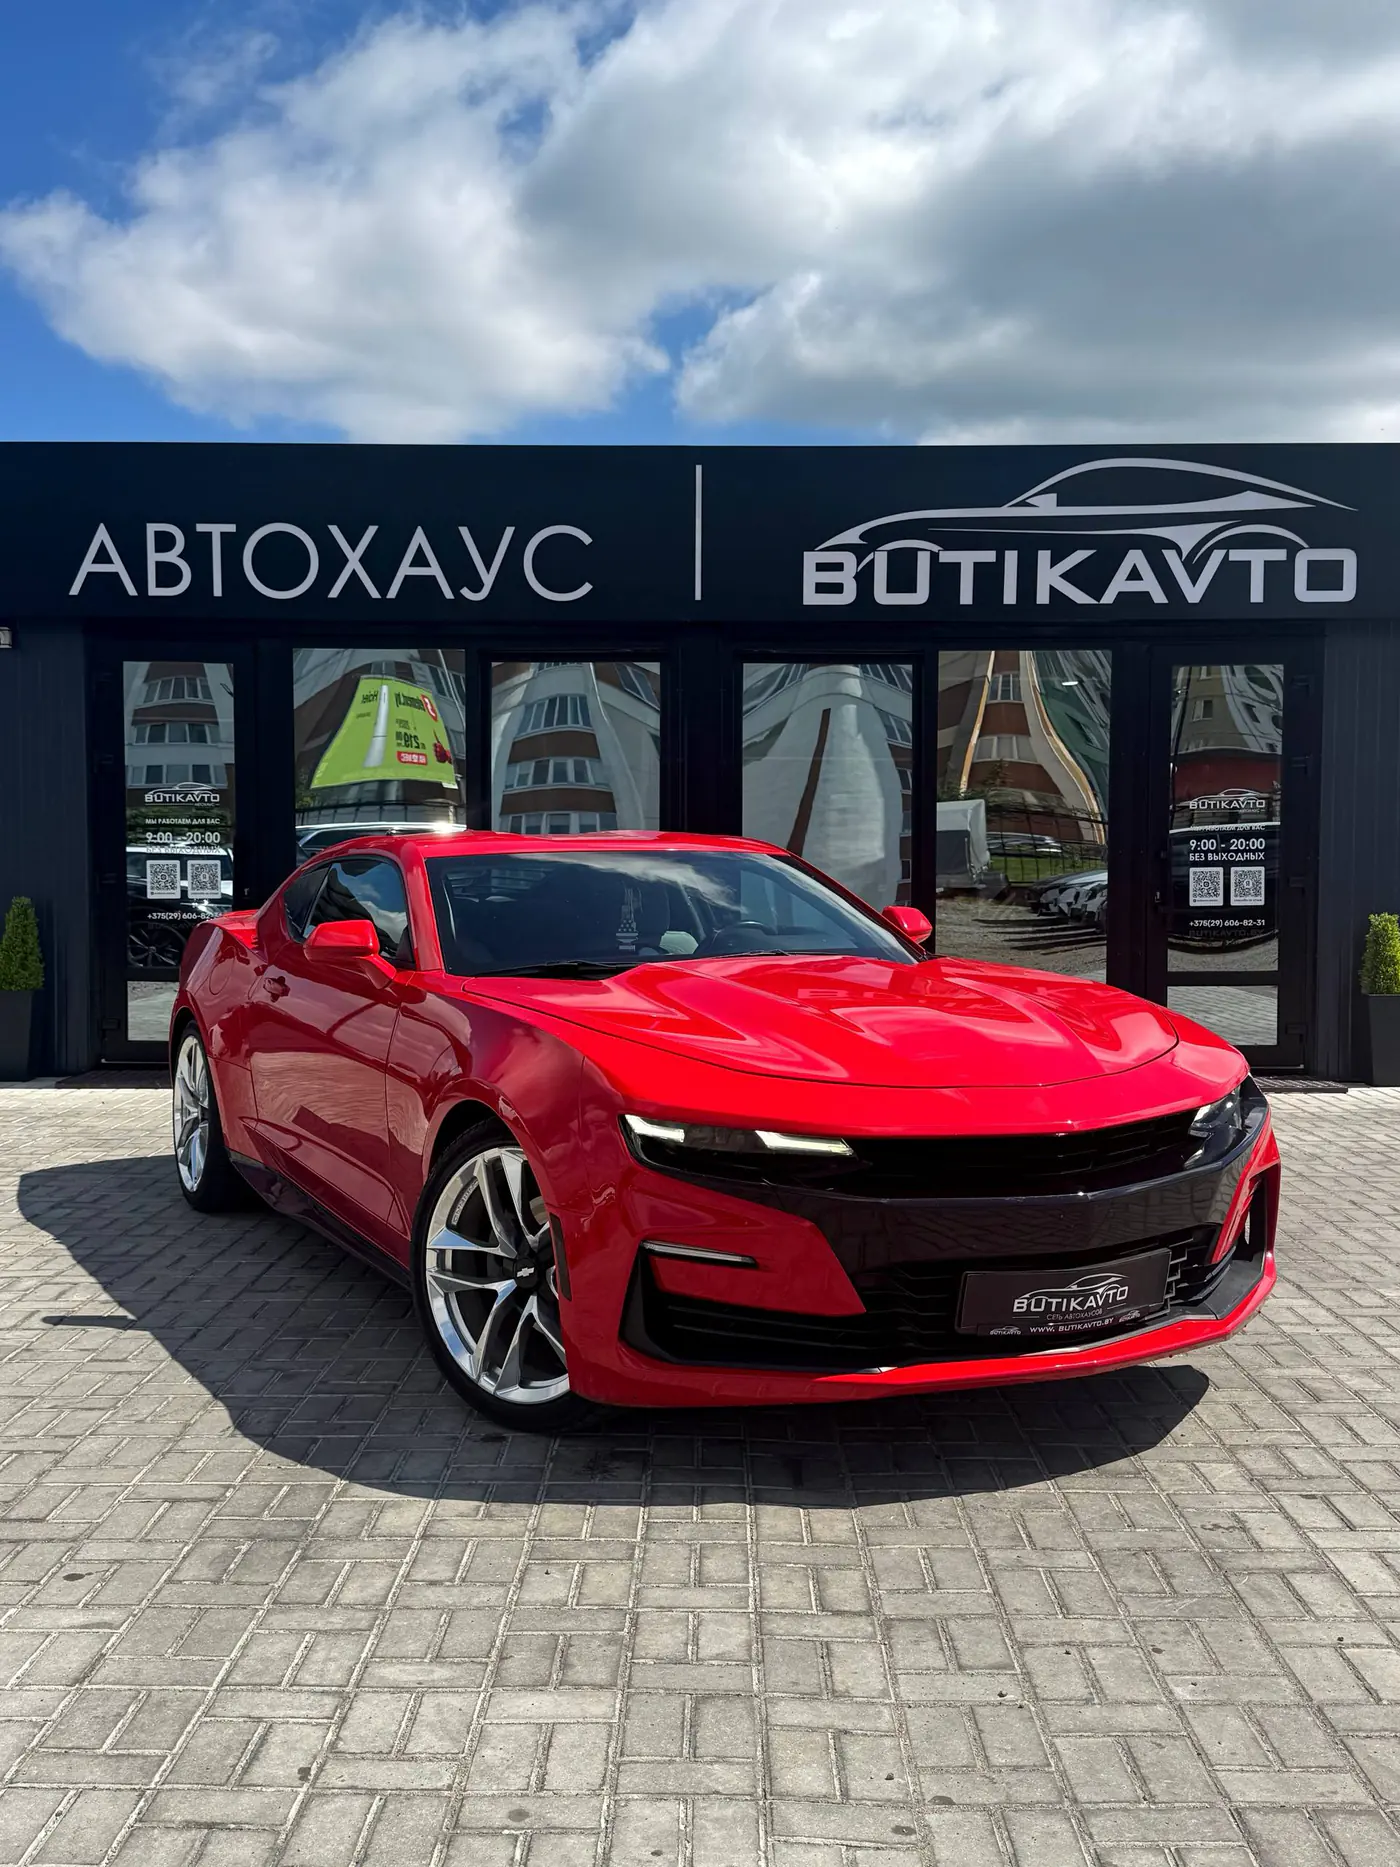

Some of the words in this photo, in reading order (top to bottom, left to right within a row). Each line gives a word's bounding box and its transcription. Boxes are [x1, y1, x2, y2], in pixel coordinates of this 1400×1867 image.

[68, 522, 594, 601] АВТОХАУС
[803, 547, 1357, 606] BUTIKAVTO
[144, 793, 220, 803] BUTIKAVTO
[1189, 799, 1266, 809] BUTIKAVTO
[145, 832, 172, 843] 9:00
[185, 832, 220, 843] 20:00
[1189, 839, 1216, 850] 9:00
[1230, 838, 1265, 850] 20:00
[1189, 853, 1205, 861] БЕЗ
[1207, 852, 1265, 861] ВЫХОДНЫХ
[147, 912, 181, 920] +375(29)
[1189, 919, 1223, 927] +375(29)
[1224, 919, 1265, 927] 606-82-31
[1012, 1286, 1129, 1313] BUTIKAVTO
[1046, 1313, 1063, 1321] СЕТЬ
[1058, 1317, 1114, 1332] BUTIKAVTO.BY
